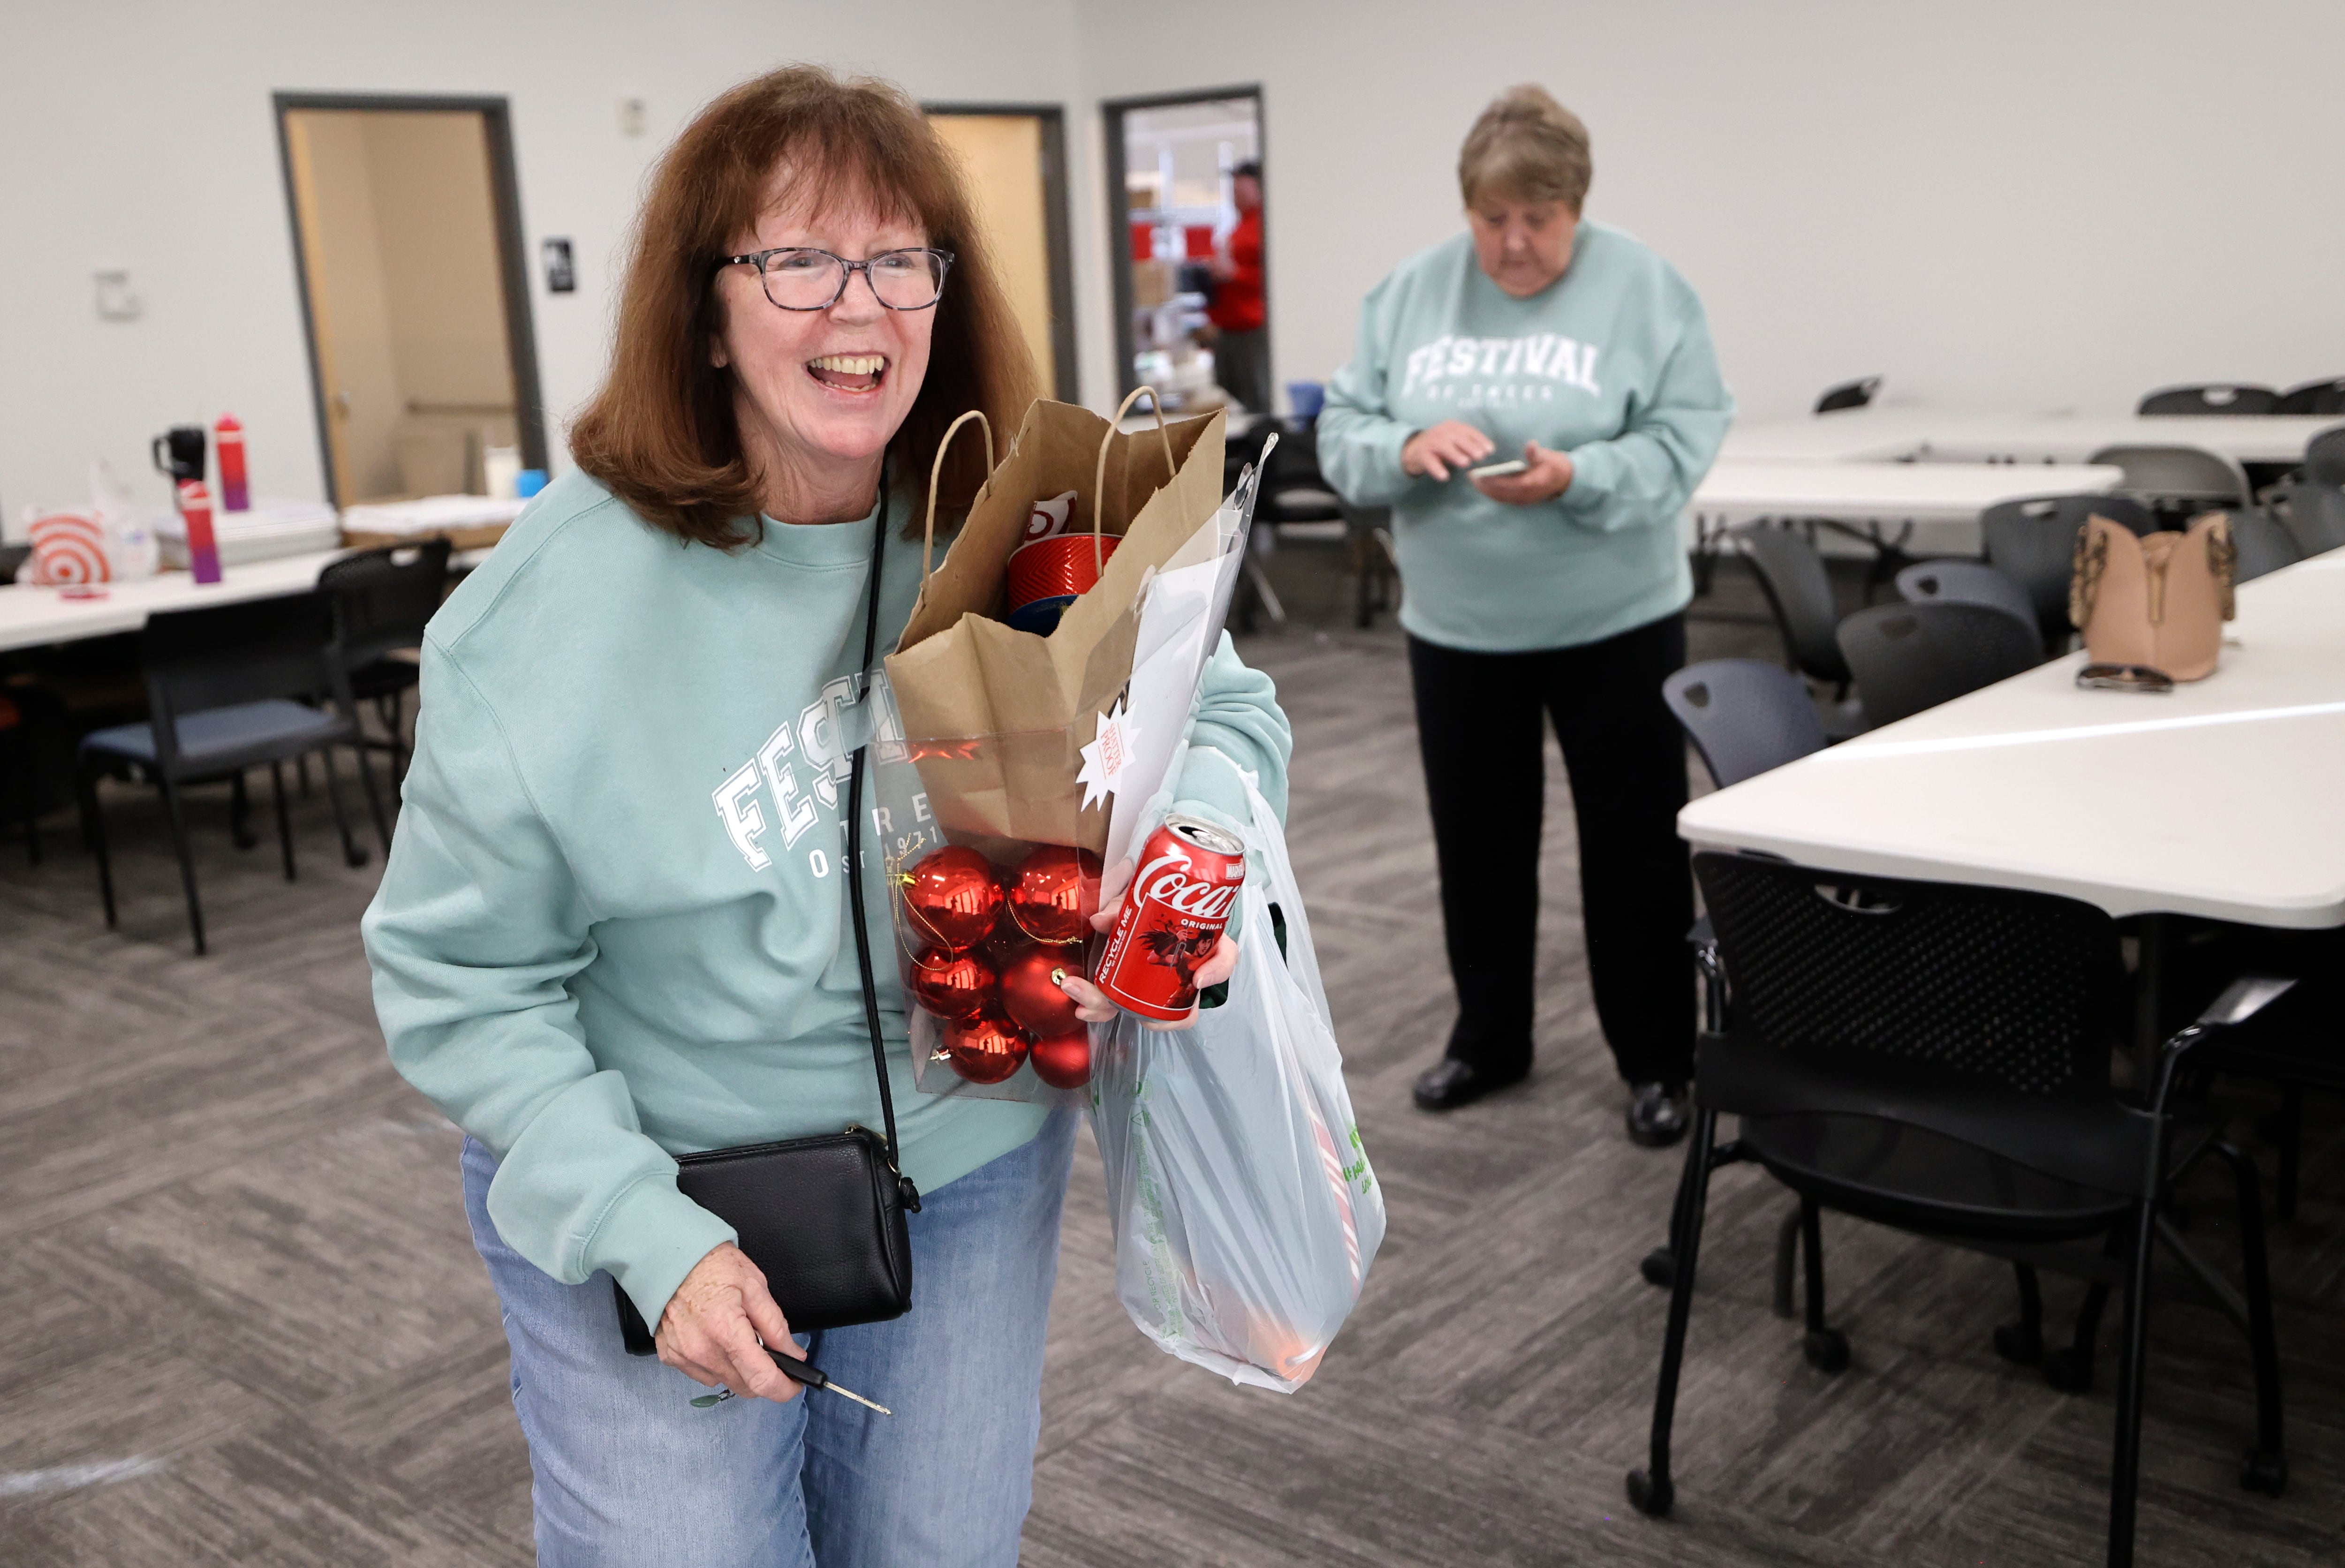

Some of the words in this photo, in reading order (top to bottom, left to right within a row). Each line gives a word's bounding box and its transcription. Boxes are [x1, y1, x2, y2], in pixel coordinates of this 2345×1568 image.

[1400, 332, 1600, 397] FESTIVAL
[1101, 730, 1116, 776] PROOF
[1109, 723, 1121, 770] SHATTER
[1099, 927, 1124, 984] RECYCLE
[1121, 905, 1132, 927] ME
[1180, 919, 1223, 930] ORIGINAL
[1142, 1260, 1157, 1296] RECYCLE
